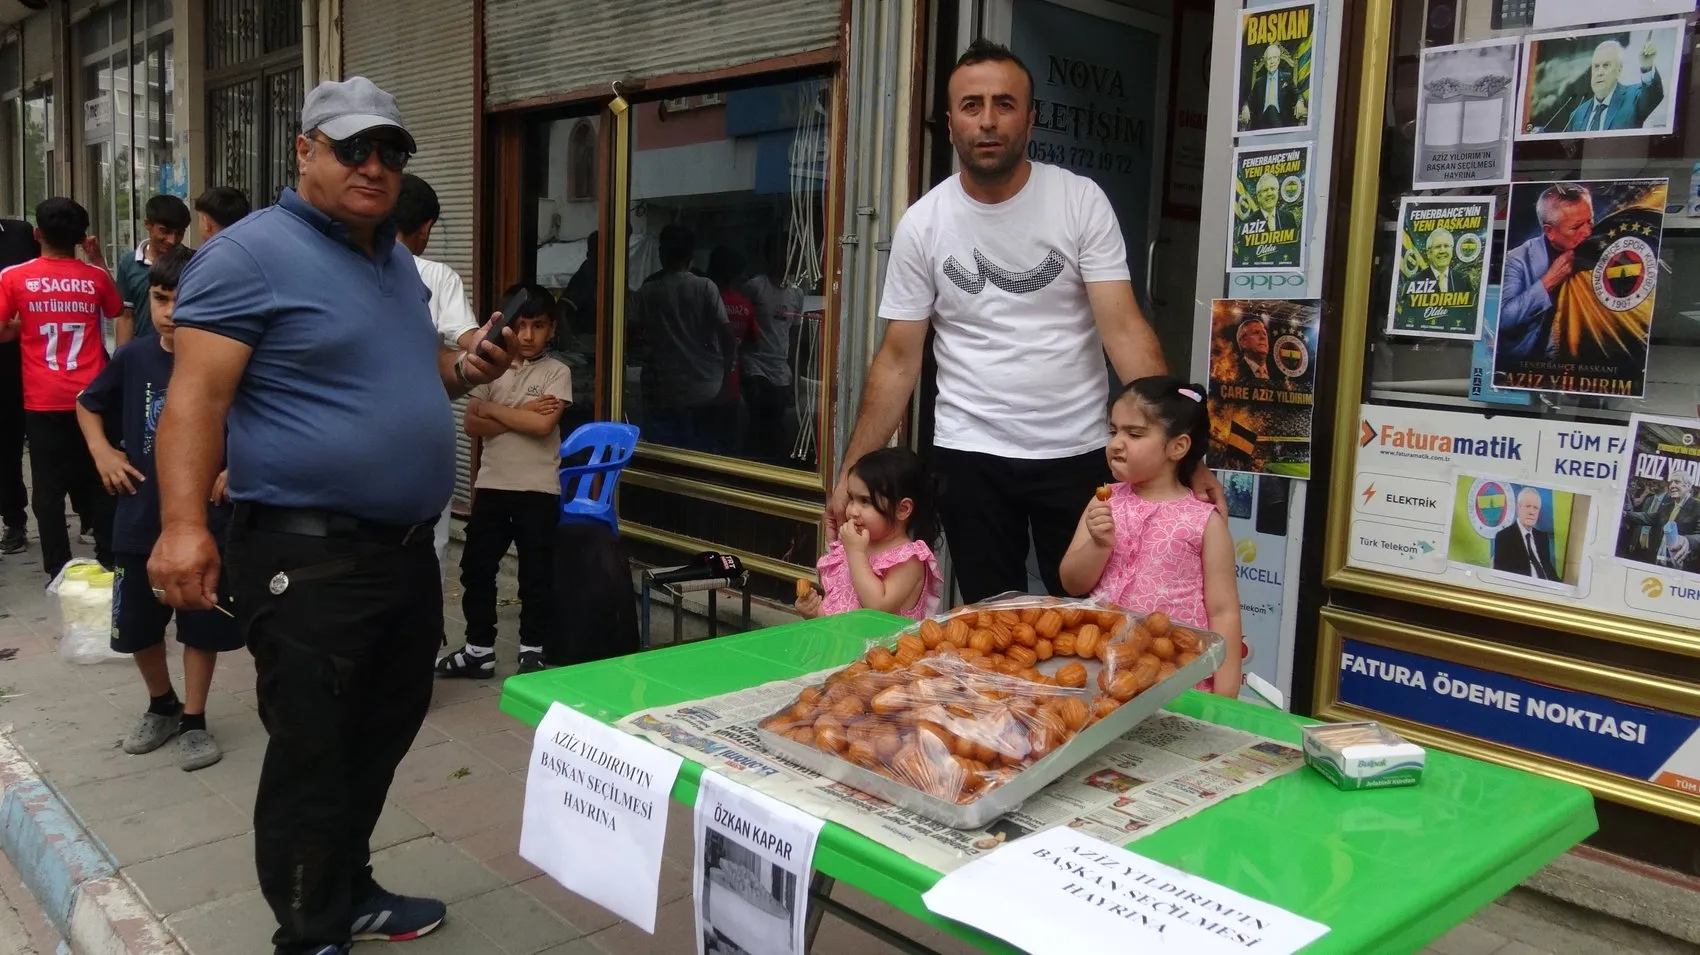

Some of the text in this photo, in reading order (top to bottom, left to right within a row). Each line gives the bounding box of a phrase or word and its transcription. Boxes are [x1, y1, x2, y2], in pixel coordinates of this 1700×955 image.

[1047, 55, 1129, 101] NOVA
[1028, 140, 1132, 175] 0543 772 19 72
[1426, 163, 1456, 172] BAŞKAN
[1444, 171, 1476, 180] HAYRINA
[1241, 219, 1266, 235] AZİZ
[1437, 216, 1481, 233] BAŞKANI
[1244, 228, 1295, 246] YILDIRIM
[1623, 239, 1644, 252] SPOR
[1256, 244, 1276, 256] Oldu
[41, 278, 95, 295] SAGRES
[1406, 278, 1437, 294] AZİZ
[1410, 292, 1470, 307] YILDIRIM
[1611, 298, 1631, 309] 1907
[1424, 306, 1448, 318] Oldu
[40, 322, 86, 371] 17
[1506, 370, 1544, 388] AZİZ
[1220, 384, 1313, 405] ÇARE AZİZ YILDIRIM
[1380, 424, 1522, 461] Faturamatik
[1557, 430, 1601, 453] TÜM
[1380, 449, 1450, 462] www.faturamatik.com.tr
[1635, 450, 1667, 481] AZİZ
[1554, 458, 1619, 481] KREDİ
[1386, 493, 1437, 509] ELEKTRİK
[1359, 536, 1418, 555] Türk Telekom
[1235, 564, 1282, 586] RKCELL
[1240, 603, 1266, 615] elekom
[1341, 652, 1647, 745] FATURA ÖDEME NOKTASI
[551, 730, 654, 789] AZİZ YILDIRIM'IN
[540, 751, 653, 821] BAŞKAN SEÇİLMESİ
[563, 791, 617, 831] HAYRINA
[713, 802, 793, 861] ÖZKAN KAPAR
[1064, 845, 1271, 930] AZİZ YILDIRIM'IN
[1032, 848, 1263, 948] BAŞKAN SEÇİLMESİ
[1061, 882, 1167, 934] HAYRINA
